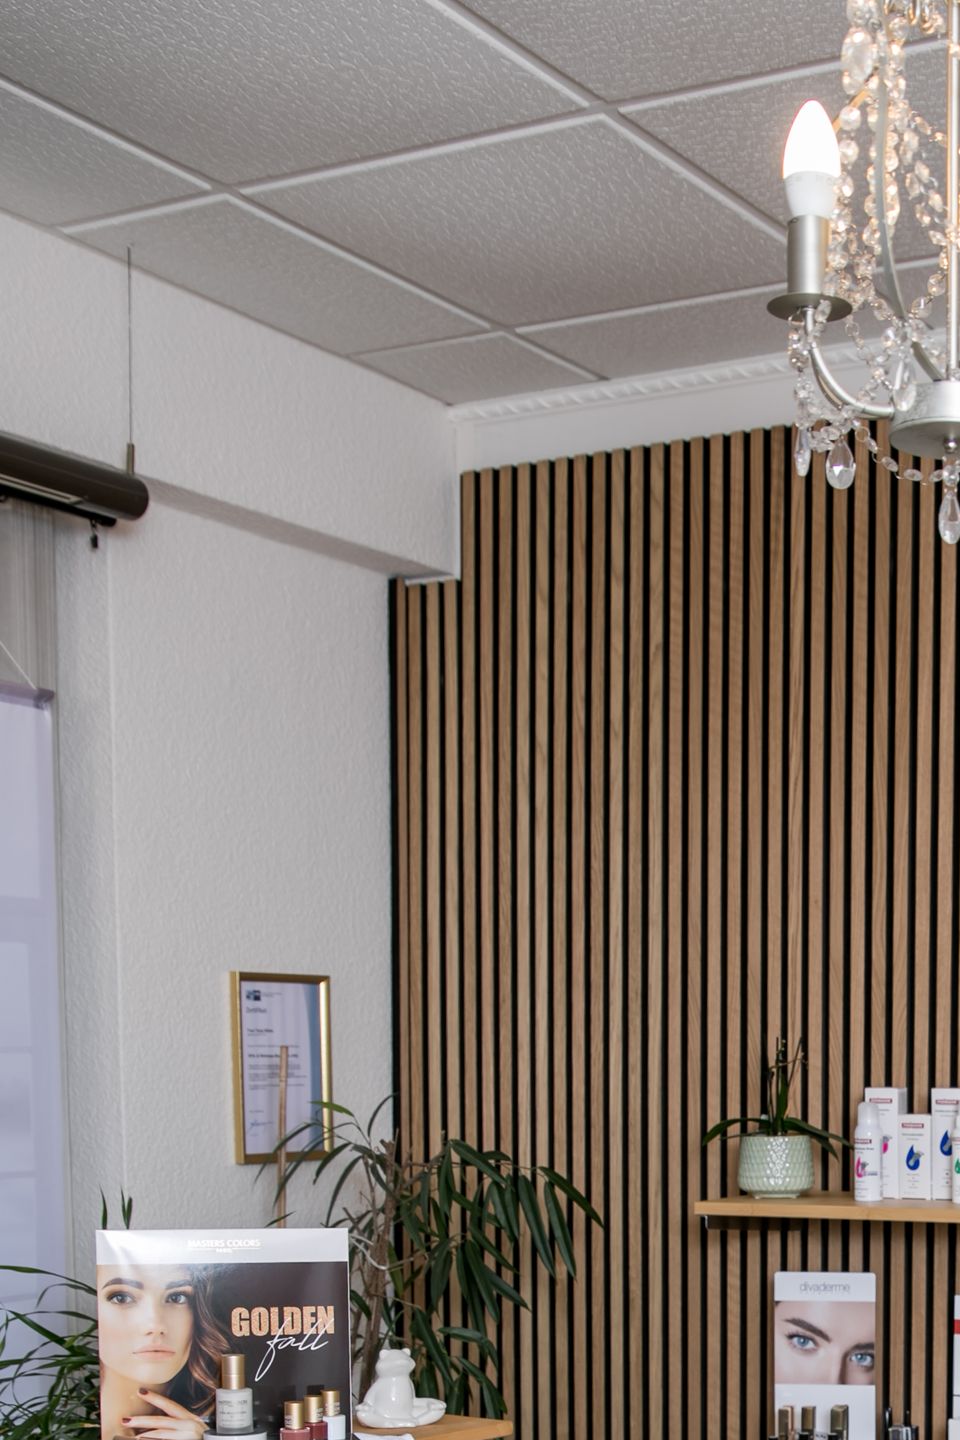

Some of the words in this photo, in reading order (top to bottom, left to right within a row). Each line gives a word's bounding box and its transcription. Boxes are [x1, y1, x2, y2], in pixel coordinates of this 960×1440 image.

[187, 1239, 225, 1248] MASTERS
[227, 1239, 261, 1247] COLORS
[231, 1305, 335, 1337] GOLDEN
[254, 1317, 335, 1382] fall
